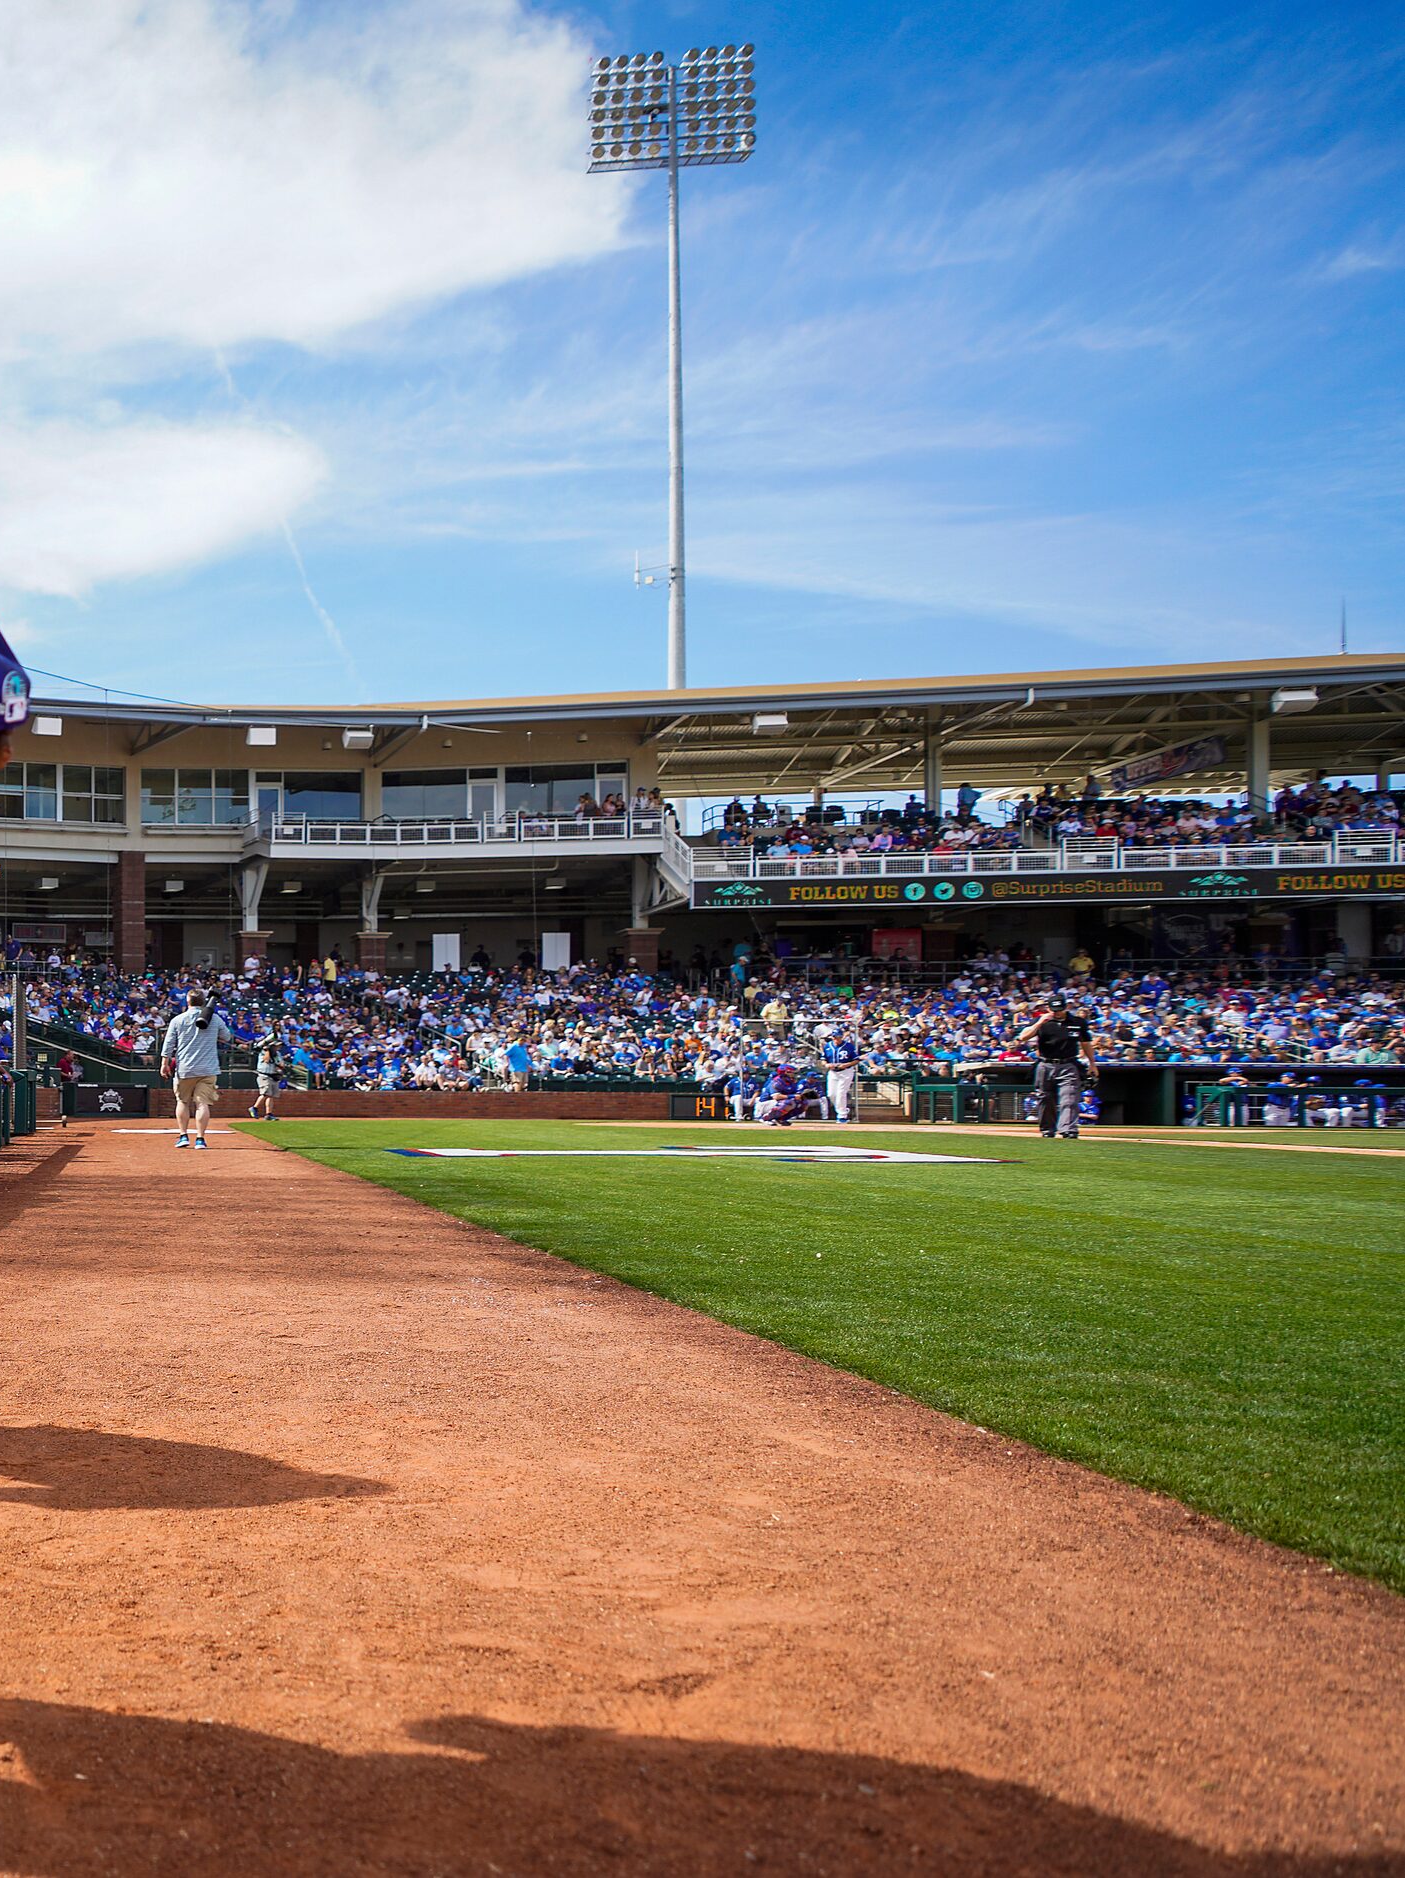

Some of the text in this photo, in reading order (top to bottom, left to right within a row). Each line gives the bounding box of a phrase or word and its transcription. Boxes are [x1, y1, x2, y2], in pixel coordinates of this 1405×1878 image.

[991, 879, 1164, 897] @SurpriseStadium
[1276, 873, 1405, 891] FOLLOW US
[789, 885, 900, 900] FOLLOW US
